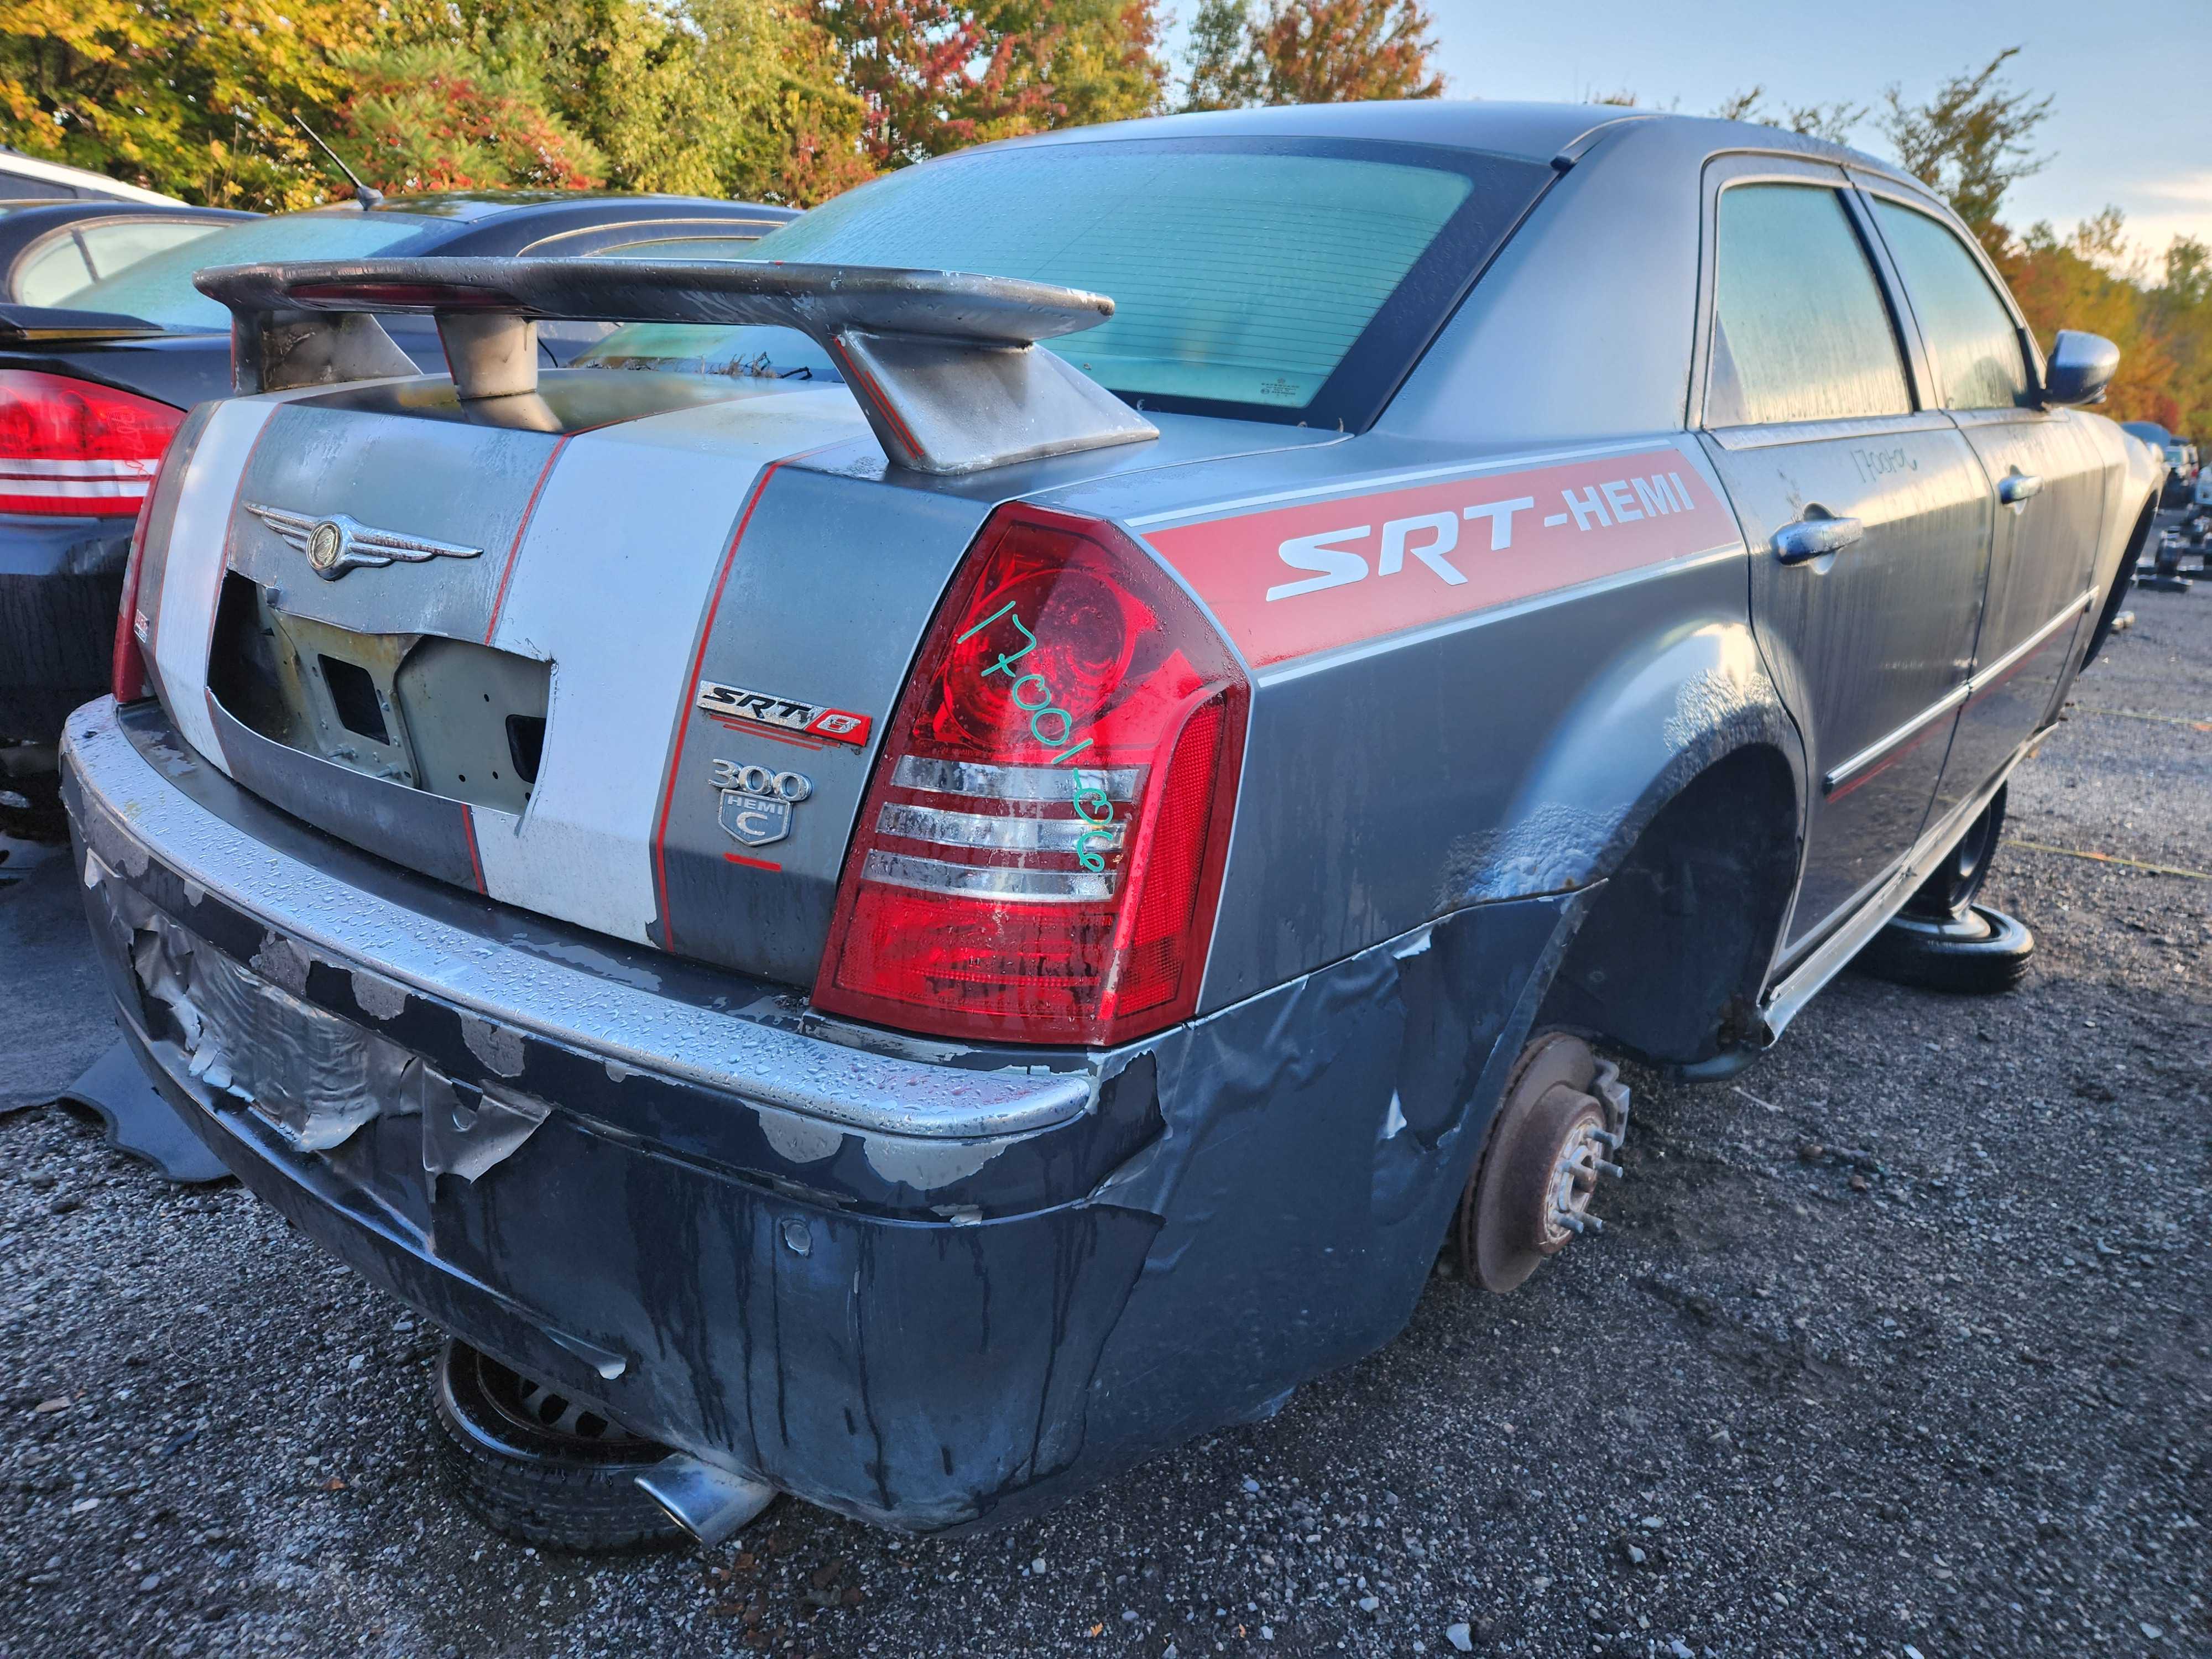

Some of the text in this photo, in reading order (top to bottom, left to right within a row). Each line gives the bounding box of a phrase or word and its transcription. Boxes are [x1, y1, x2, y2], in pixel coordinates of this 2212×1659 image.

[708, 759, 813, 802] 300
[727, 795, 784, 815] HEMI
[736, 811, 768, 836] C
